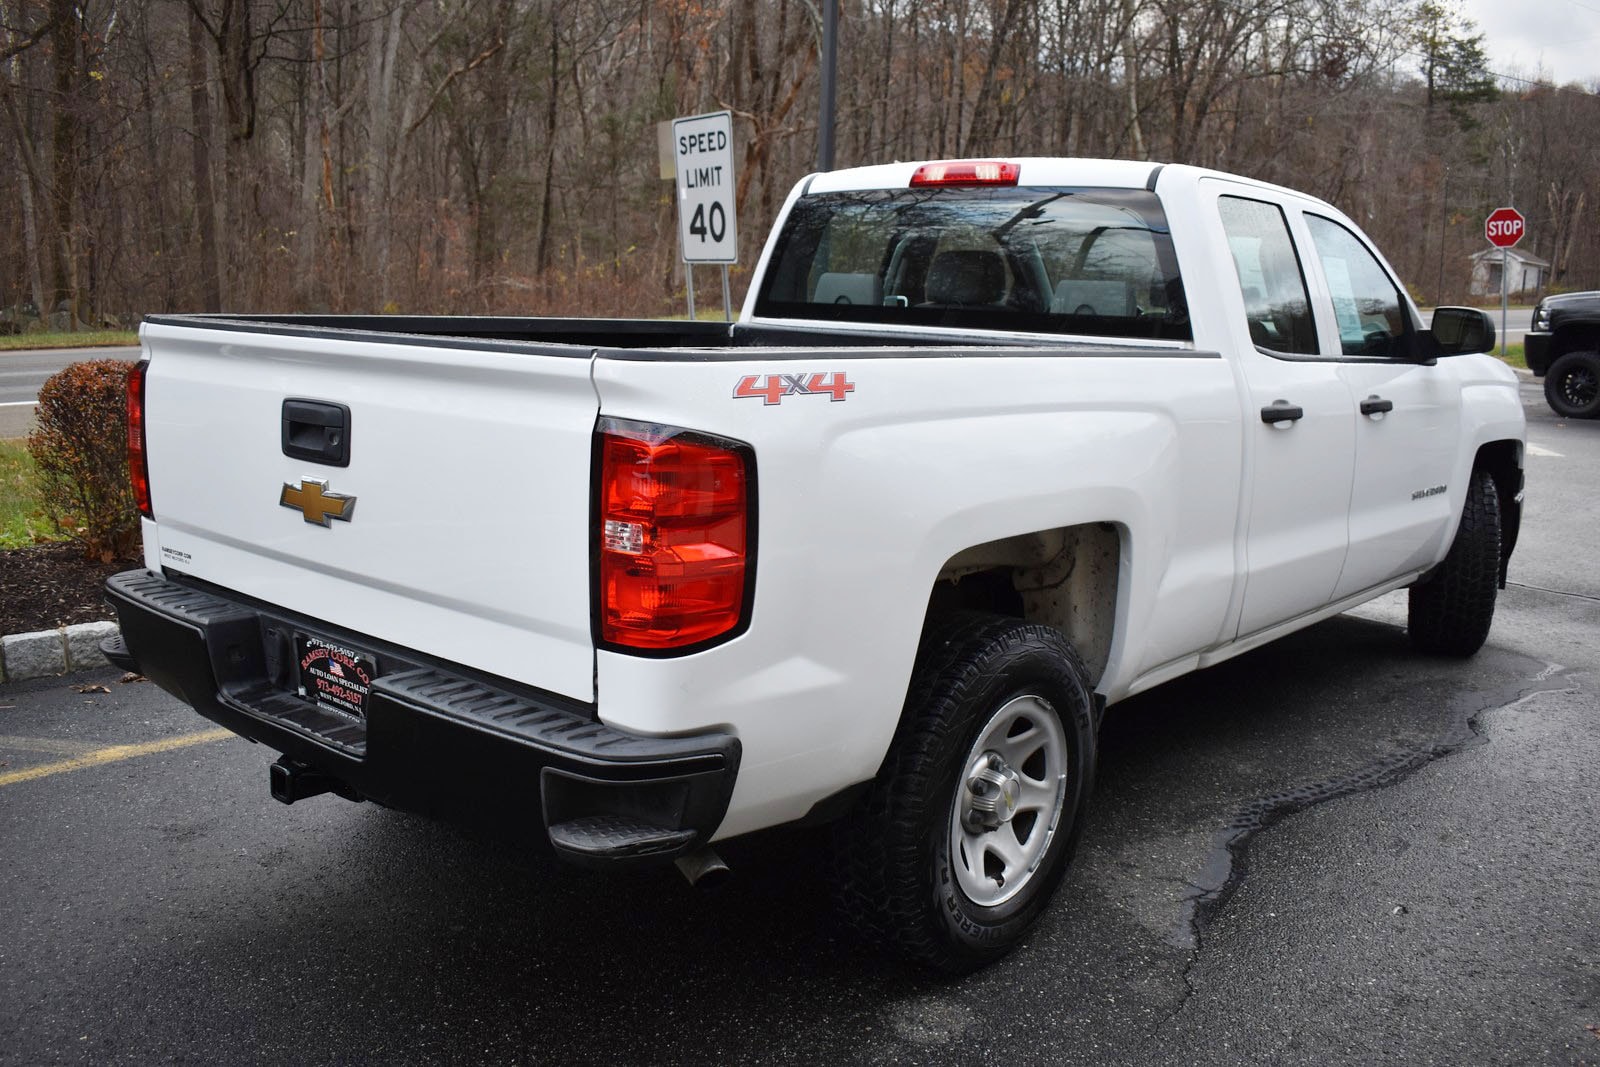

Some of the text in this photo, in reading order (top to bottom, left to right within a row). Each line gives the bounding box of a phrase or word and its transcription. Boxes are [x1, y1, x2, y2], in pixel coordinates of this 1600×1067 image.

[679, 130, 727, 156] SPEED
[686, 165, 723, 189] LIMIT
[689, 200, 727, 244] 40
[1488, 219, 1522, 237] STOP
[301, 648, 330, 671] RAMSEY
[309, 667, 369, 695] AUTO LOAN SPECIALIST
[315, 678, 363, 706] 973-492-5157
